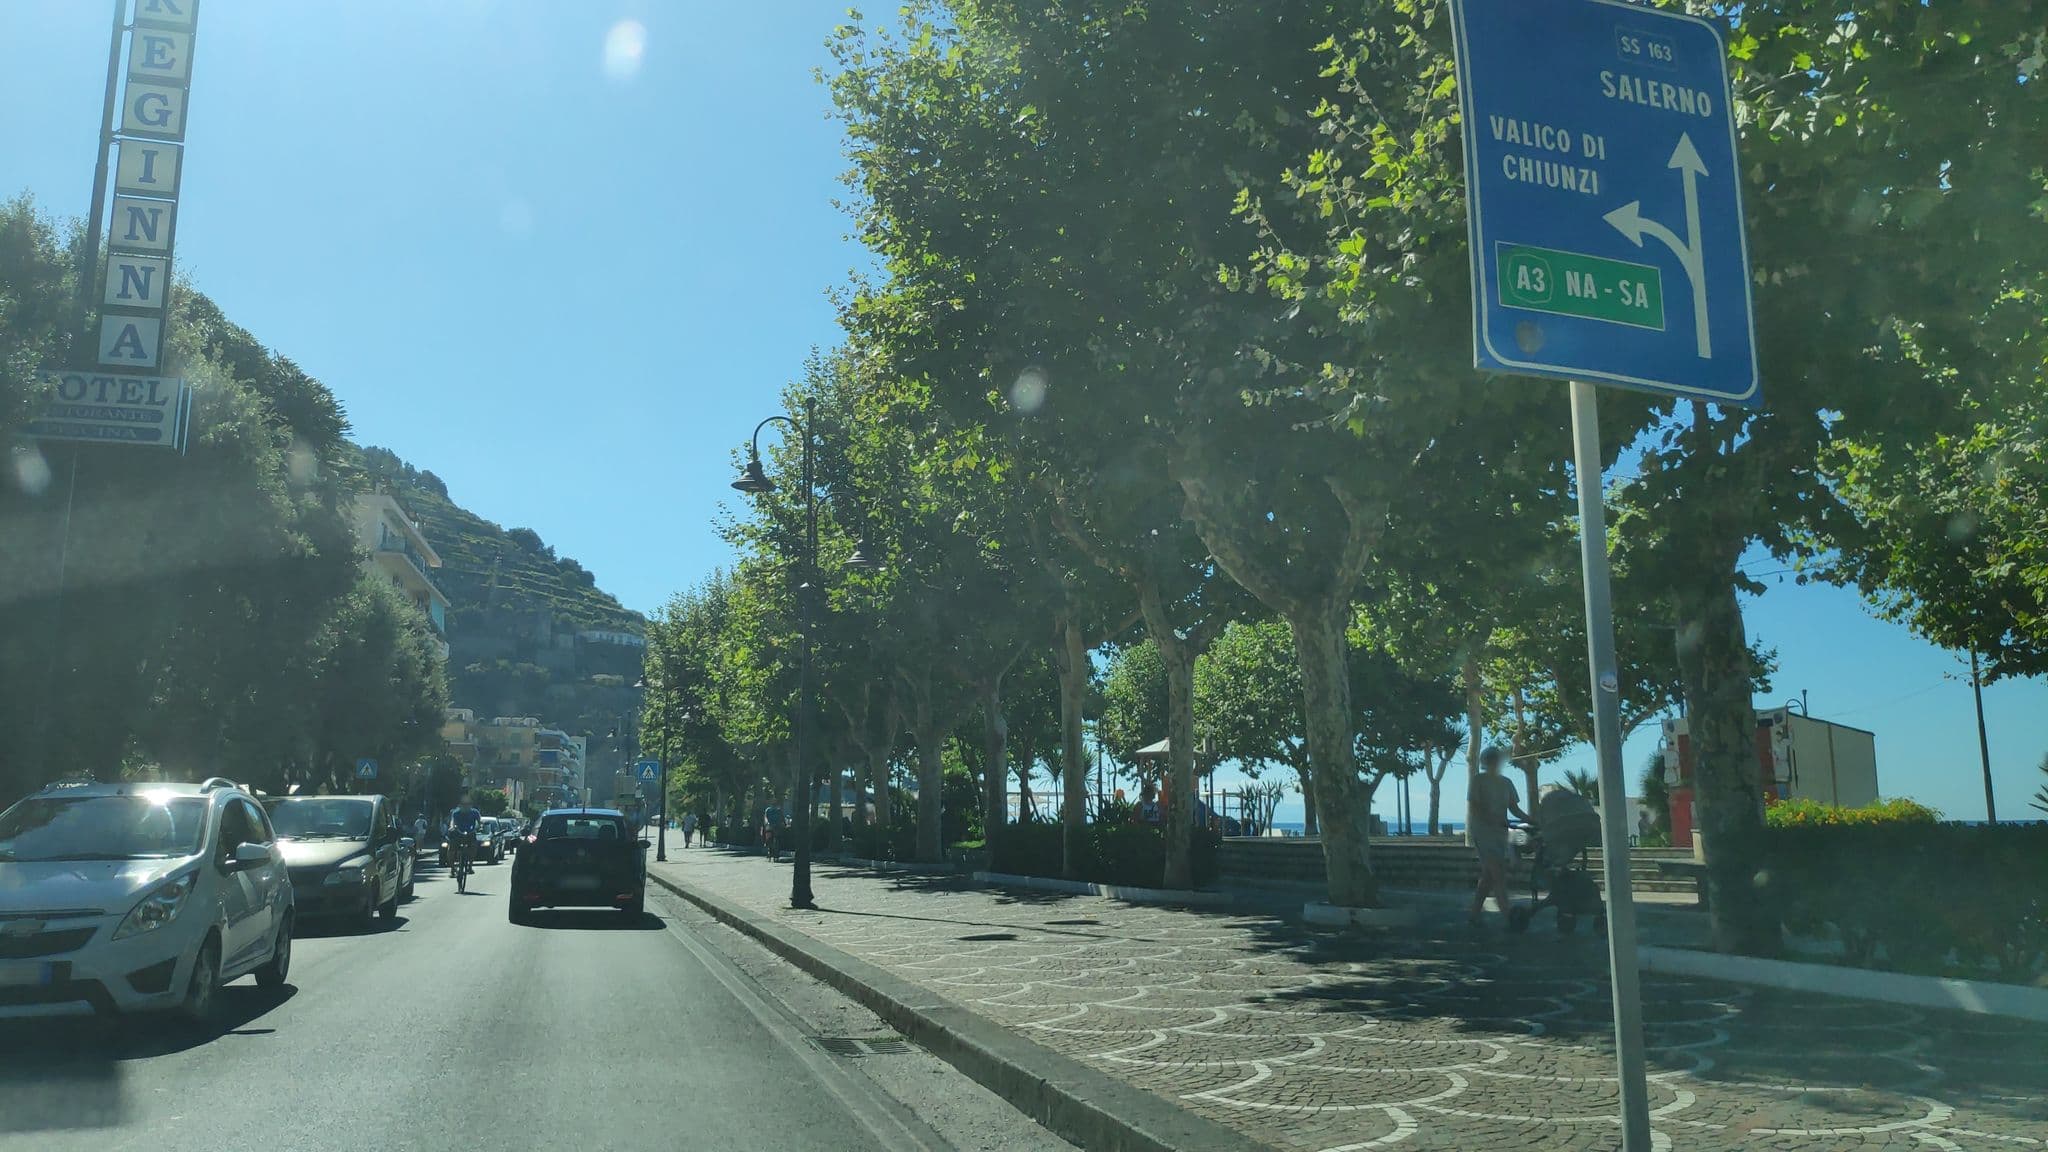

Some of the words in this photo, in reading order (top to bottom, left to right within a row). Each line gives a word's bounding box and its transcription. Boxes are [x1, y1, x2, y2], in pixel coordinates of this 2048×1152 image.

[1620, 35, 1641, 55] SS
[1647, 41, 1673, 62] 163
[1600, 70, 1712, 118] SALERNO
[1489, 114, 1571, 153] VALICO
[1581, 132, 1606, 160] DI
[1502, 154, 1599, 195] CHIUNZI
[1516, 264, 1546, 293] A3
